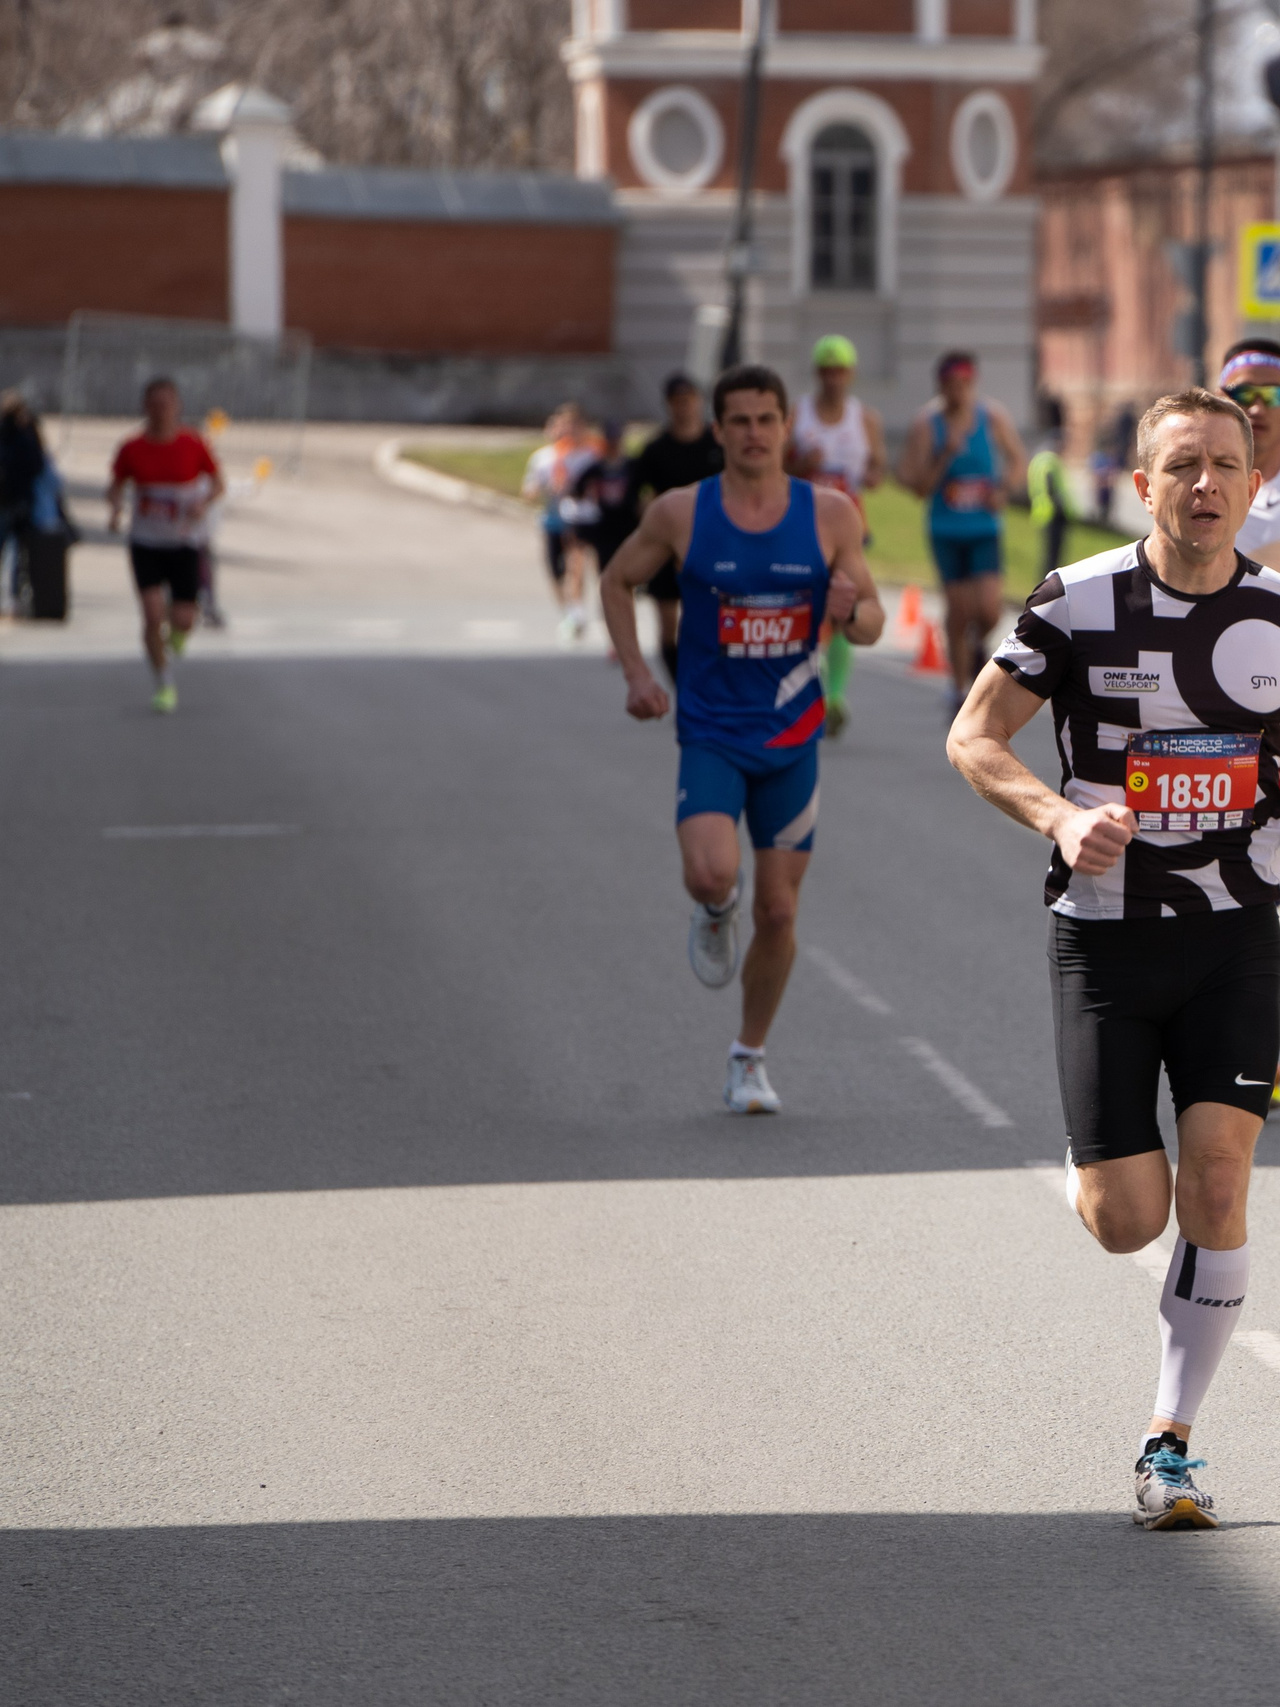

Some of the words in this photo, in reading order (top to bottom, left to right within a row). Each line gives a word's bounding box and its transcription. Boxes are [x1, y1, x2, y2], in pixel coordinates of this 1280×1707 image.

[740, 617, 794, 643] 1047
[1103, 672, 1127, 680] ONE
[1130, 672, 1160, 681] TEAM
[1104, 681, 1152, 689] VELOSPORT
[1156, 773, 1232, 809] 1830
